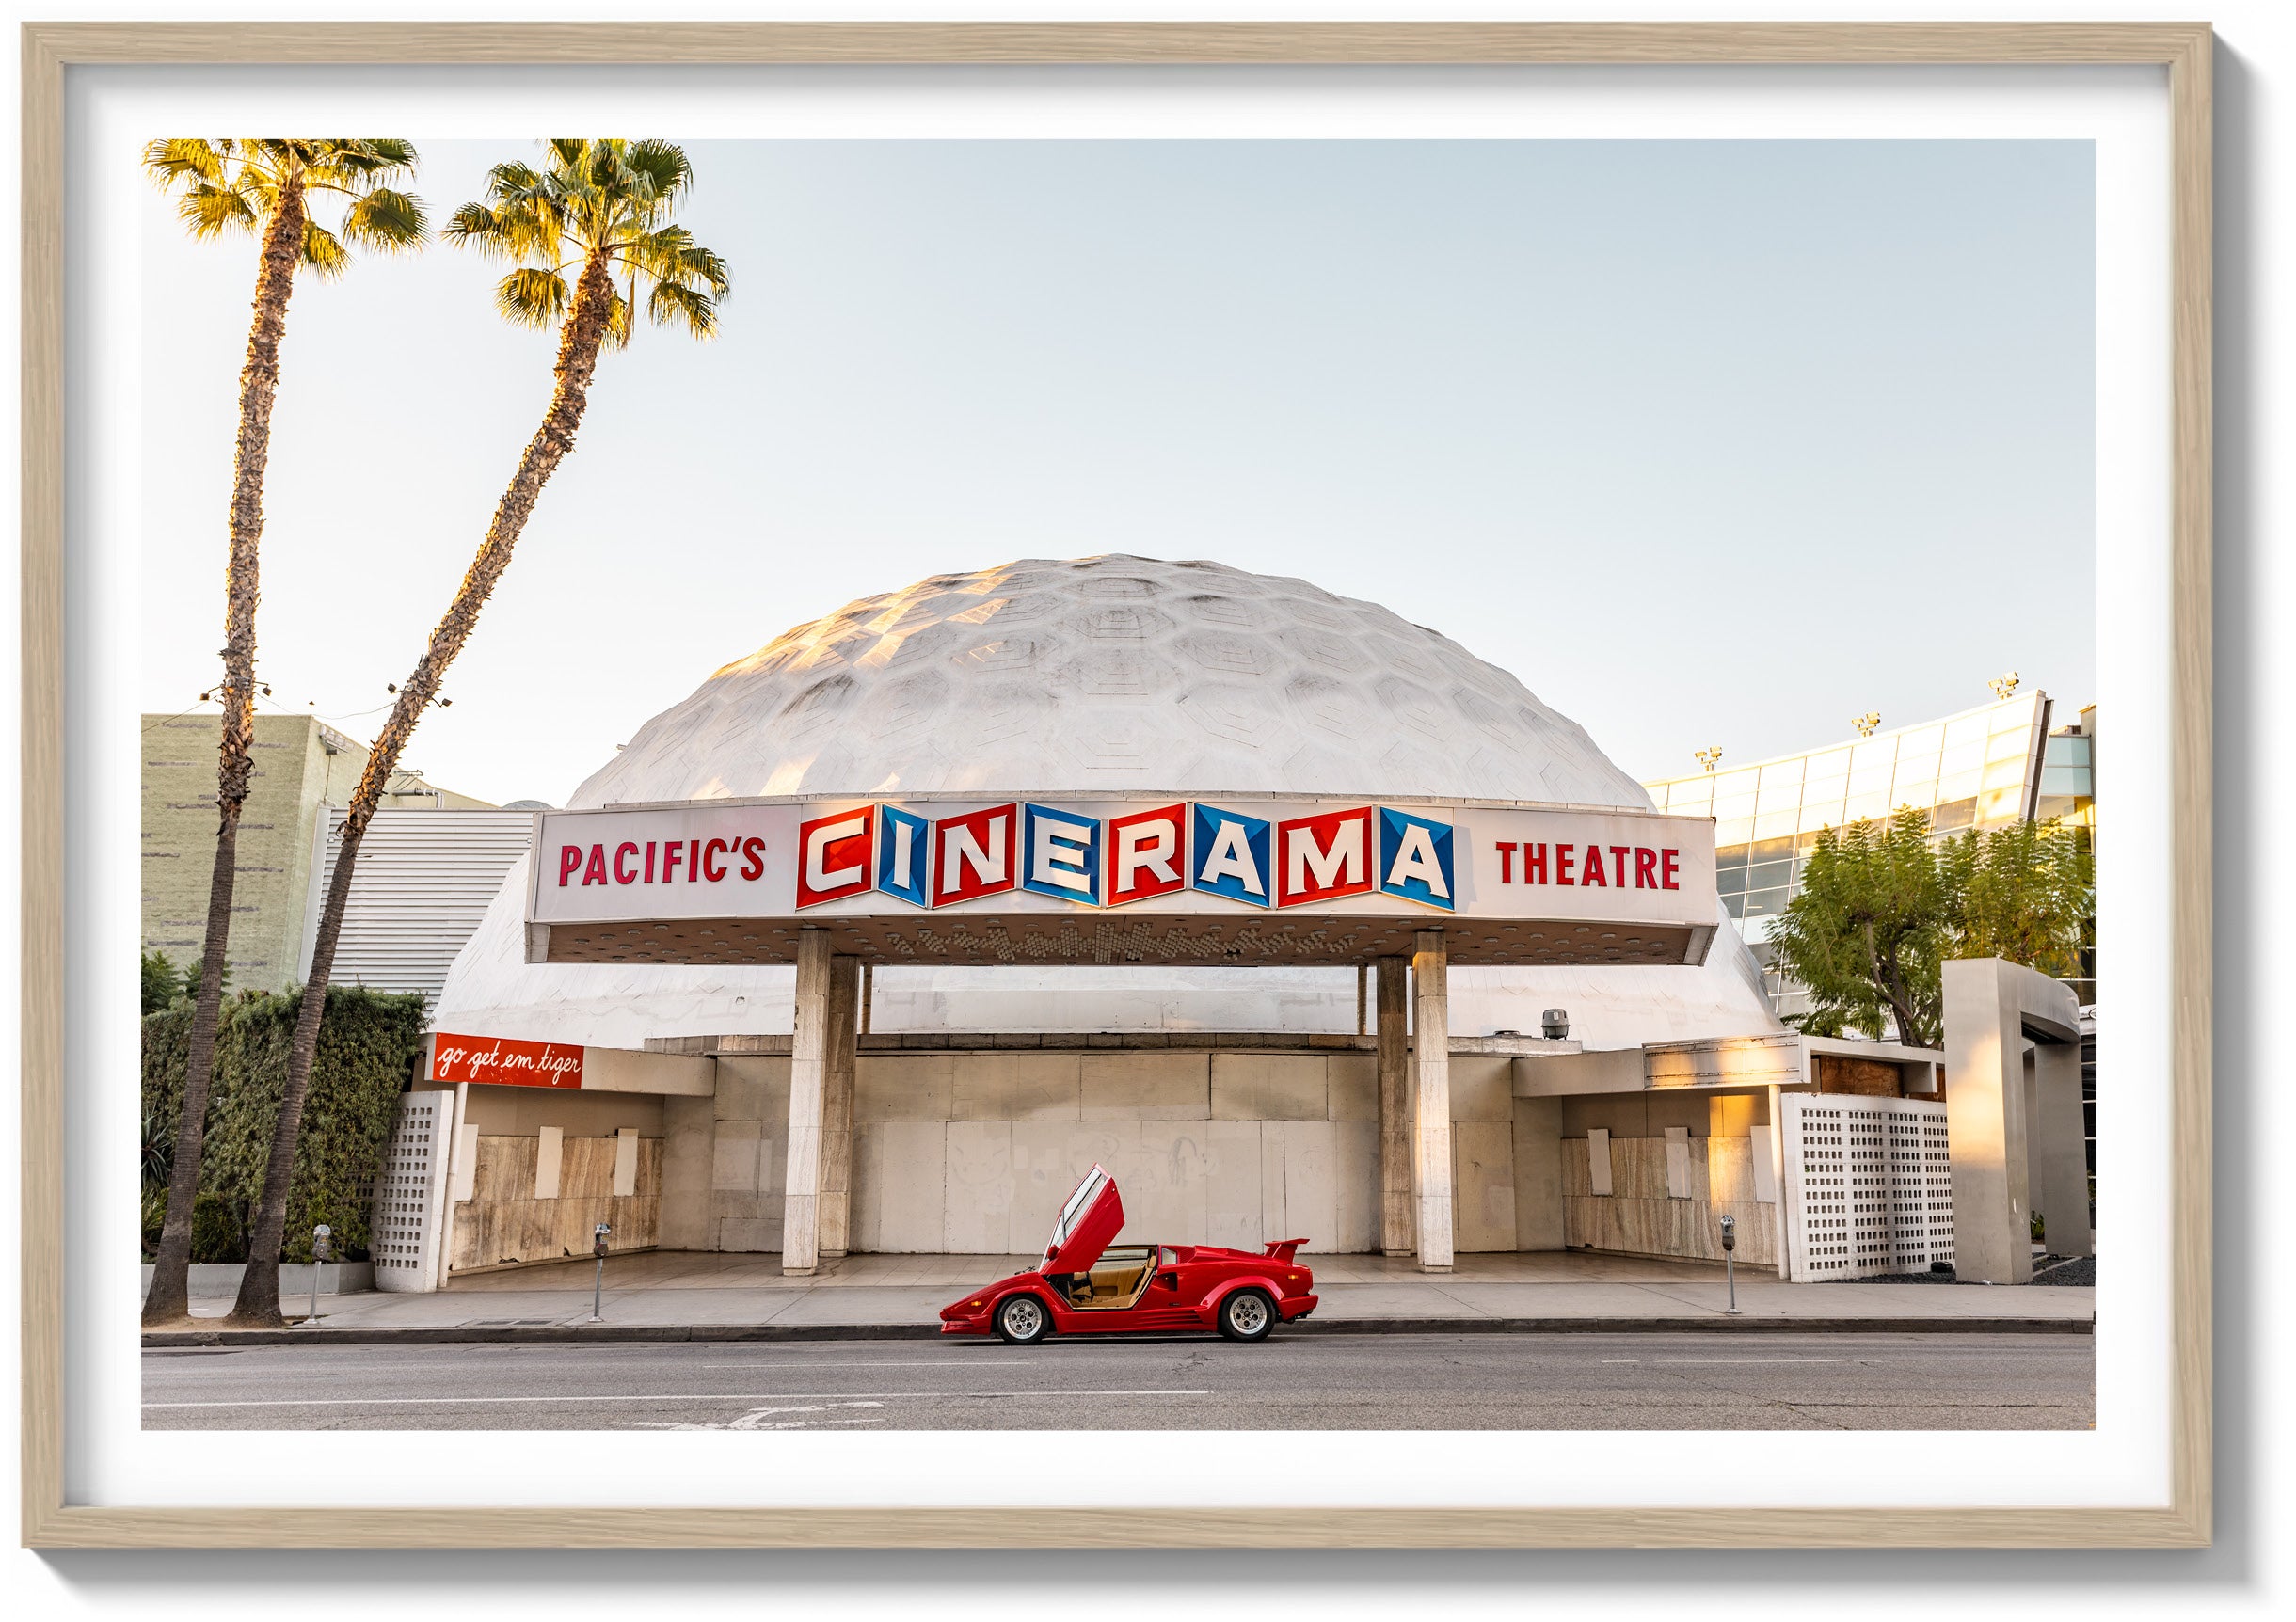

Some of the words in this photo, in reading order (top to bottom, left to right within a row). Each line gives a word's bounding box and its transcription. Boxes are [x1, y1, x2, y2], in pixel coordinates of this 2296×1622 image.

[559, 836, 766, 886] PACIFIC'S
[806, 815, 1451, 898] CINERAMA
[1495, 840, 1680, 890] THEATRE
[438, 1047, 467, 1078] go
[467, 1040, 501, 1079] get
[501, 1053, 535, 1070] em
[536, 1044, 582, 1085] tiger
